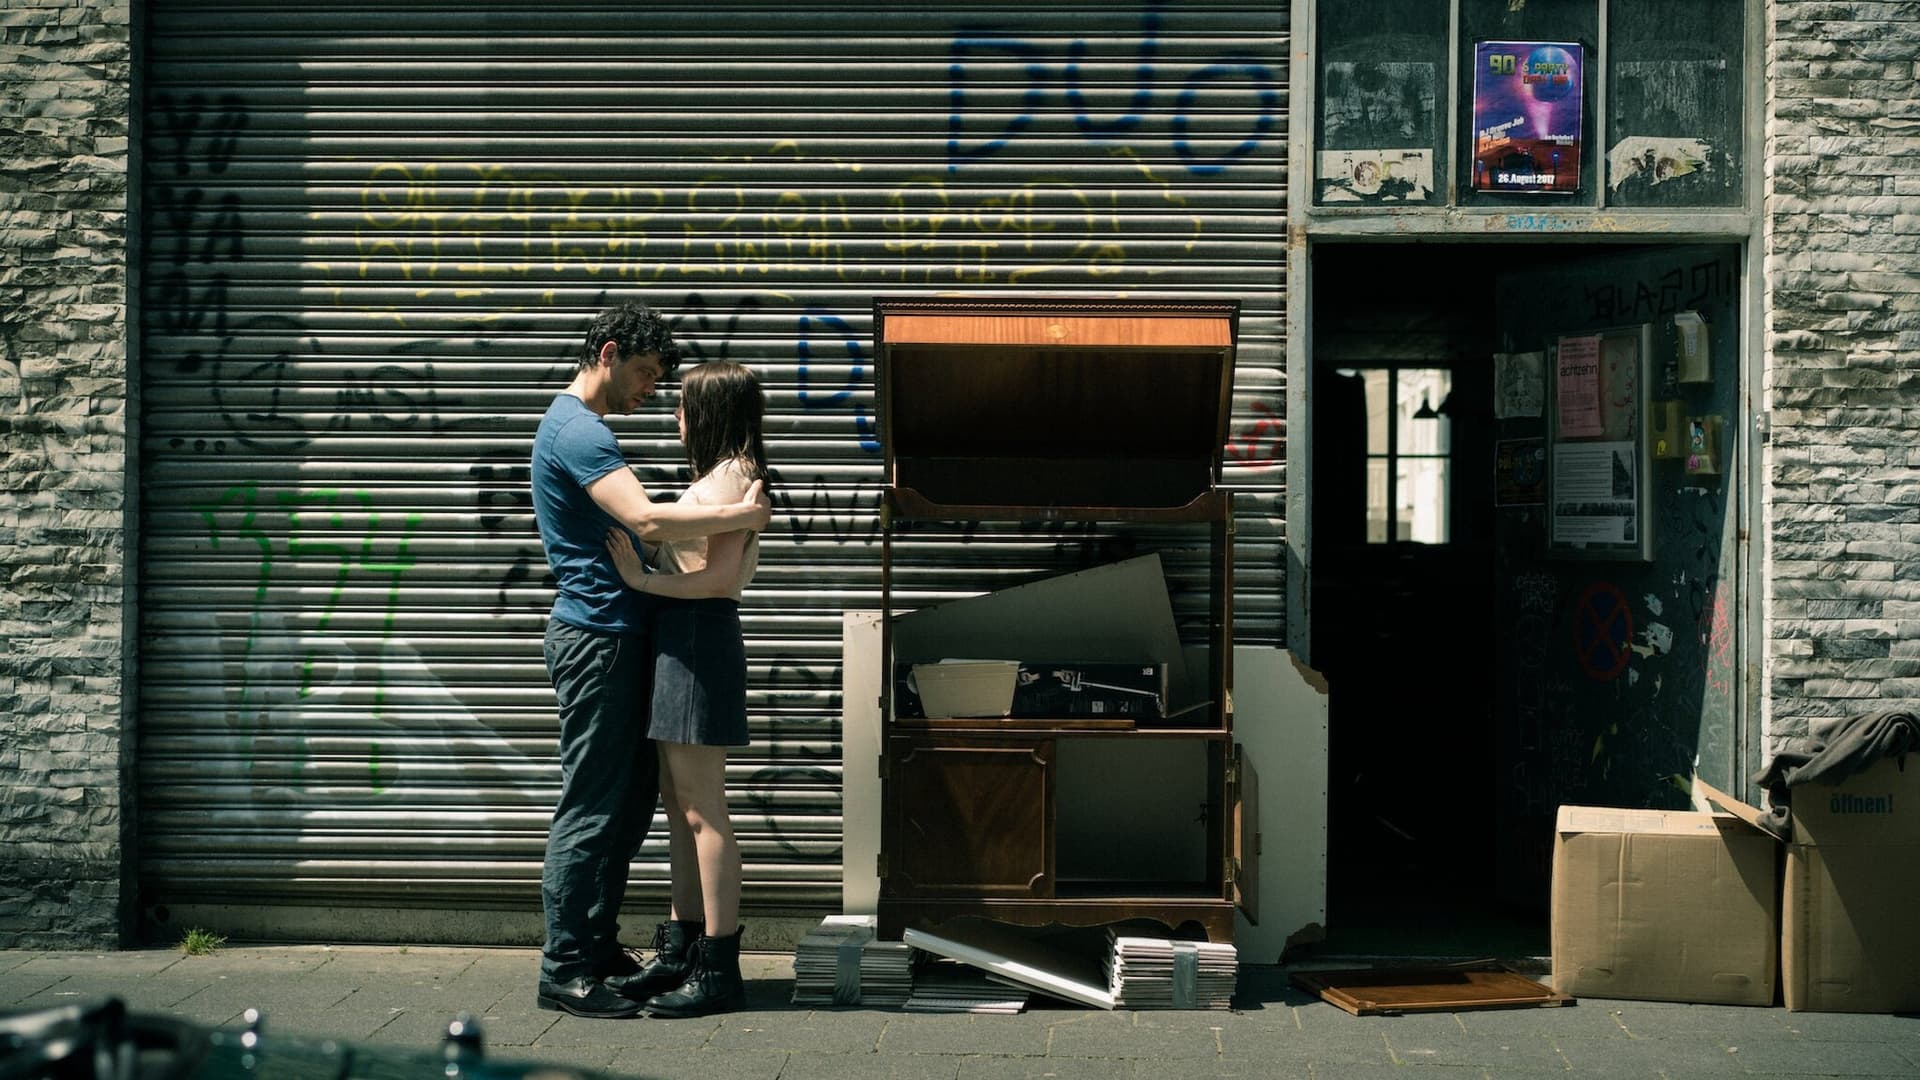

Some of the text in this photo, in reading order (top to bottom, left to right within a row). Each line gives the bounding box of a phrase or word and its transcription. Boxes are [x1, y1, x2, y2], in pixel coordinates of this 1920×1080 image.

[1537, 174, 1555, 185] 2017
[1559, 362, 1598, 377] achtzehn
[1830, 792, 1894, 814] öffnen!
